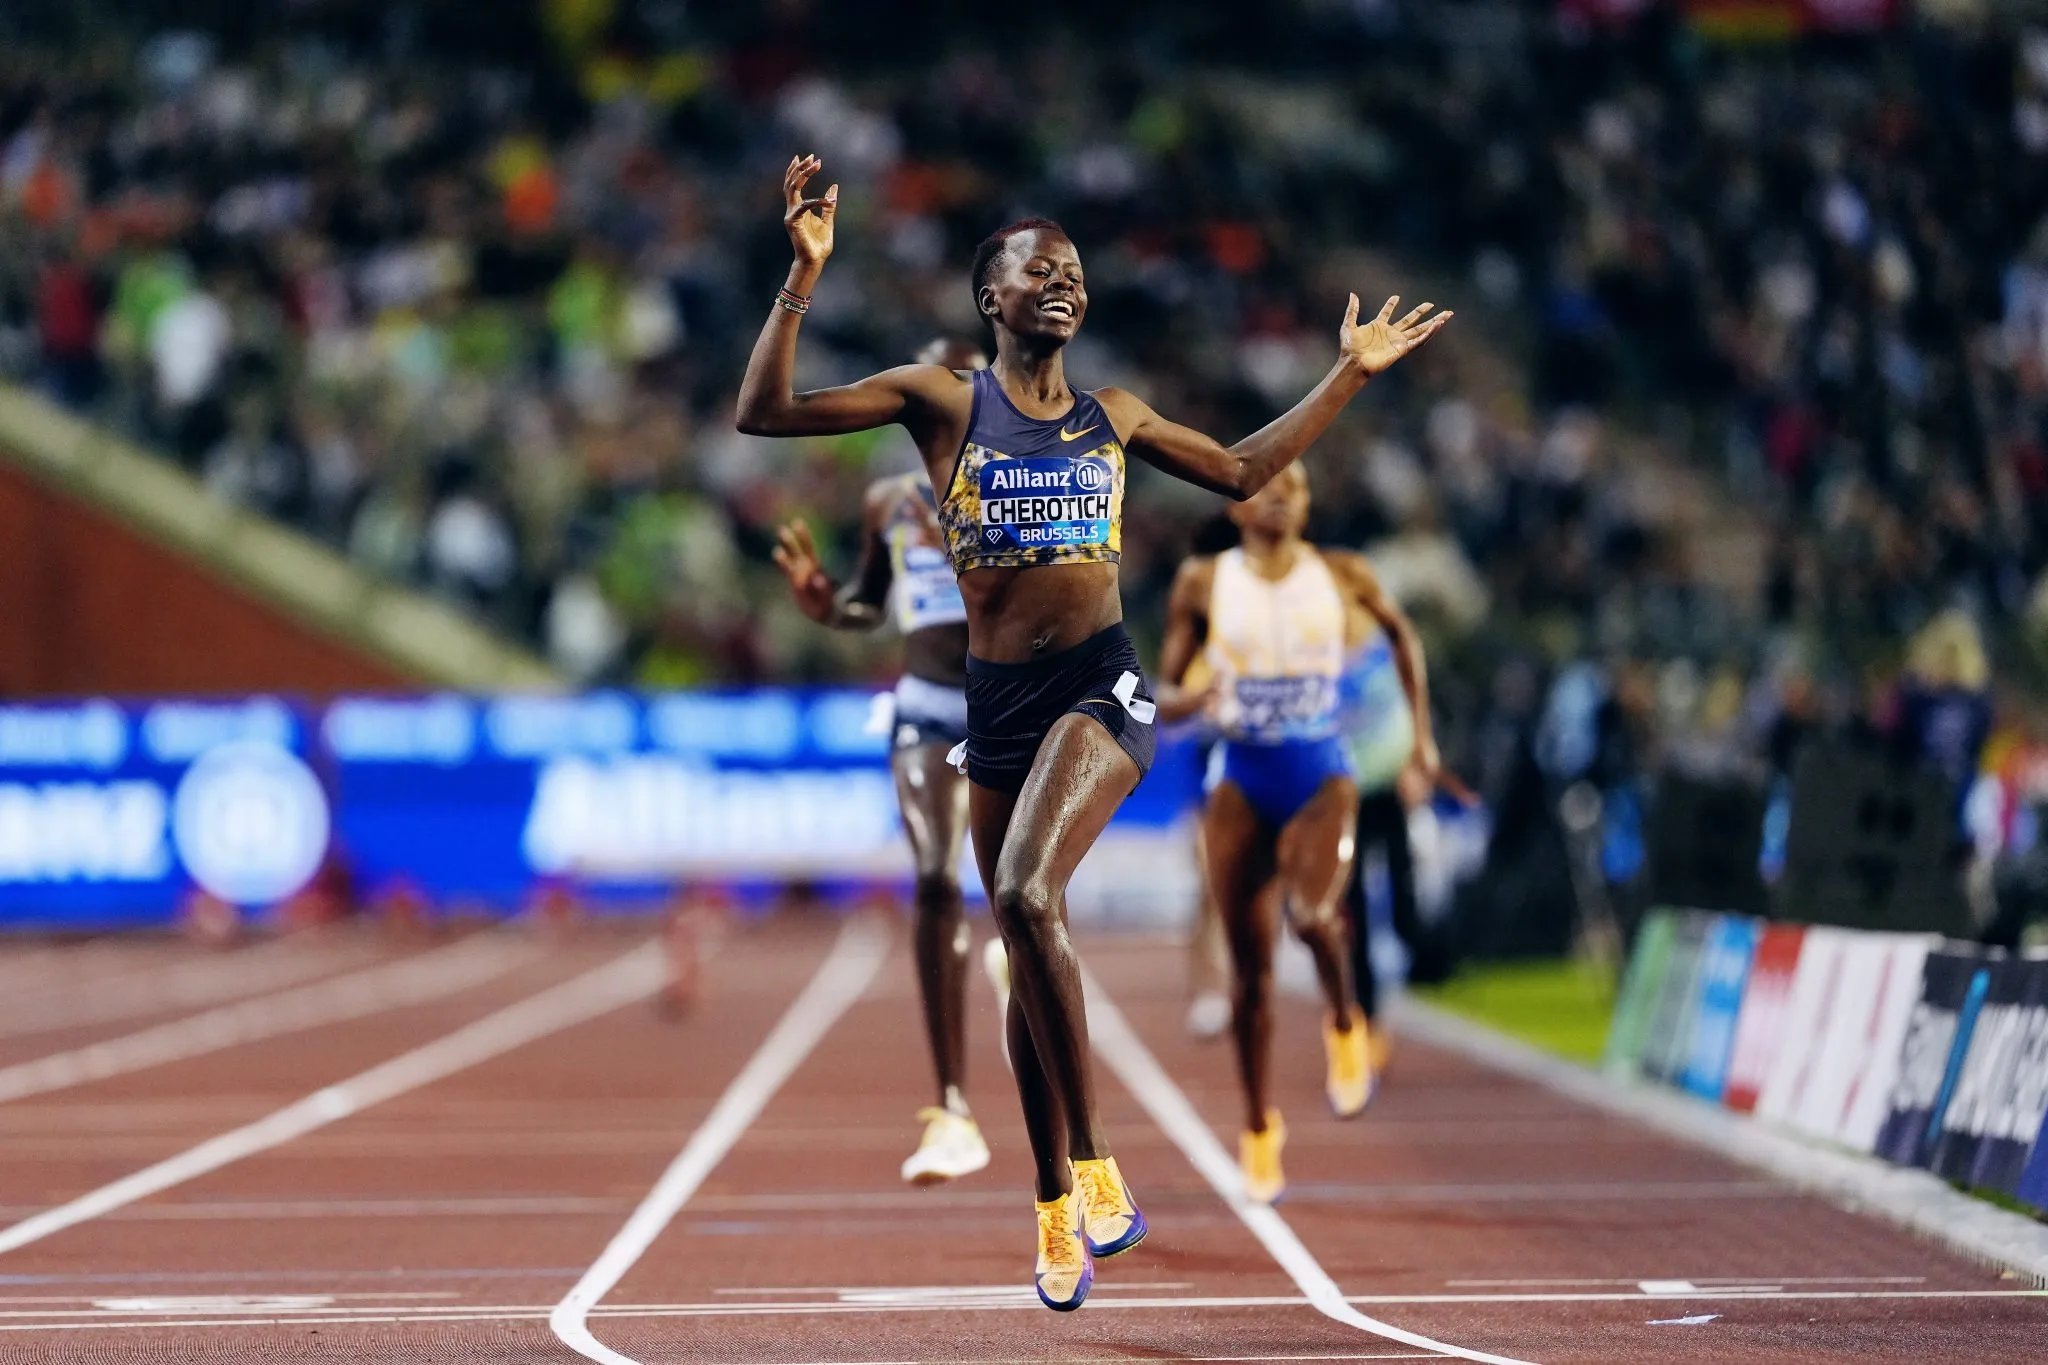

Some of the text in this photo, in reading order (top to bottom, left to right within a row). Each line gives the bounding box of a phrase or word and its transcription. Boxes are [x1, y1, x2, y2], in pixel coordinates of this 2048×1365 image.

[991, 468, 1071, 490] Allianz
[987, 496, 1109, 523] CHEROTICH
[1020, 526, 1099, 542] BRUSSELS
